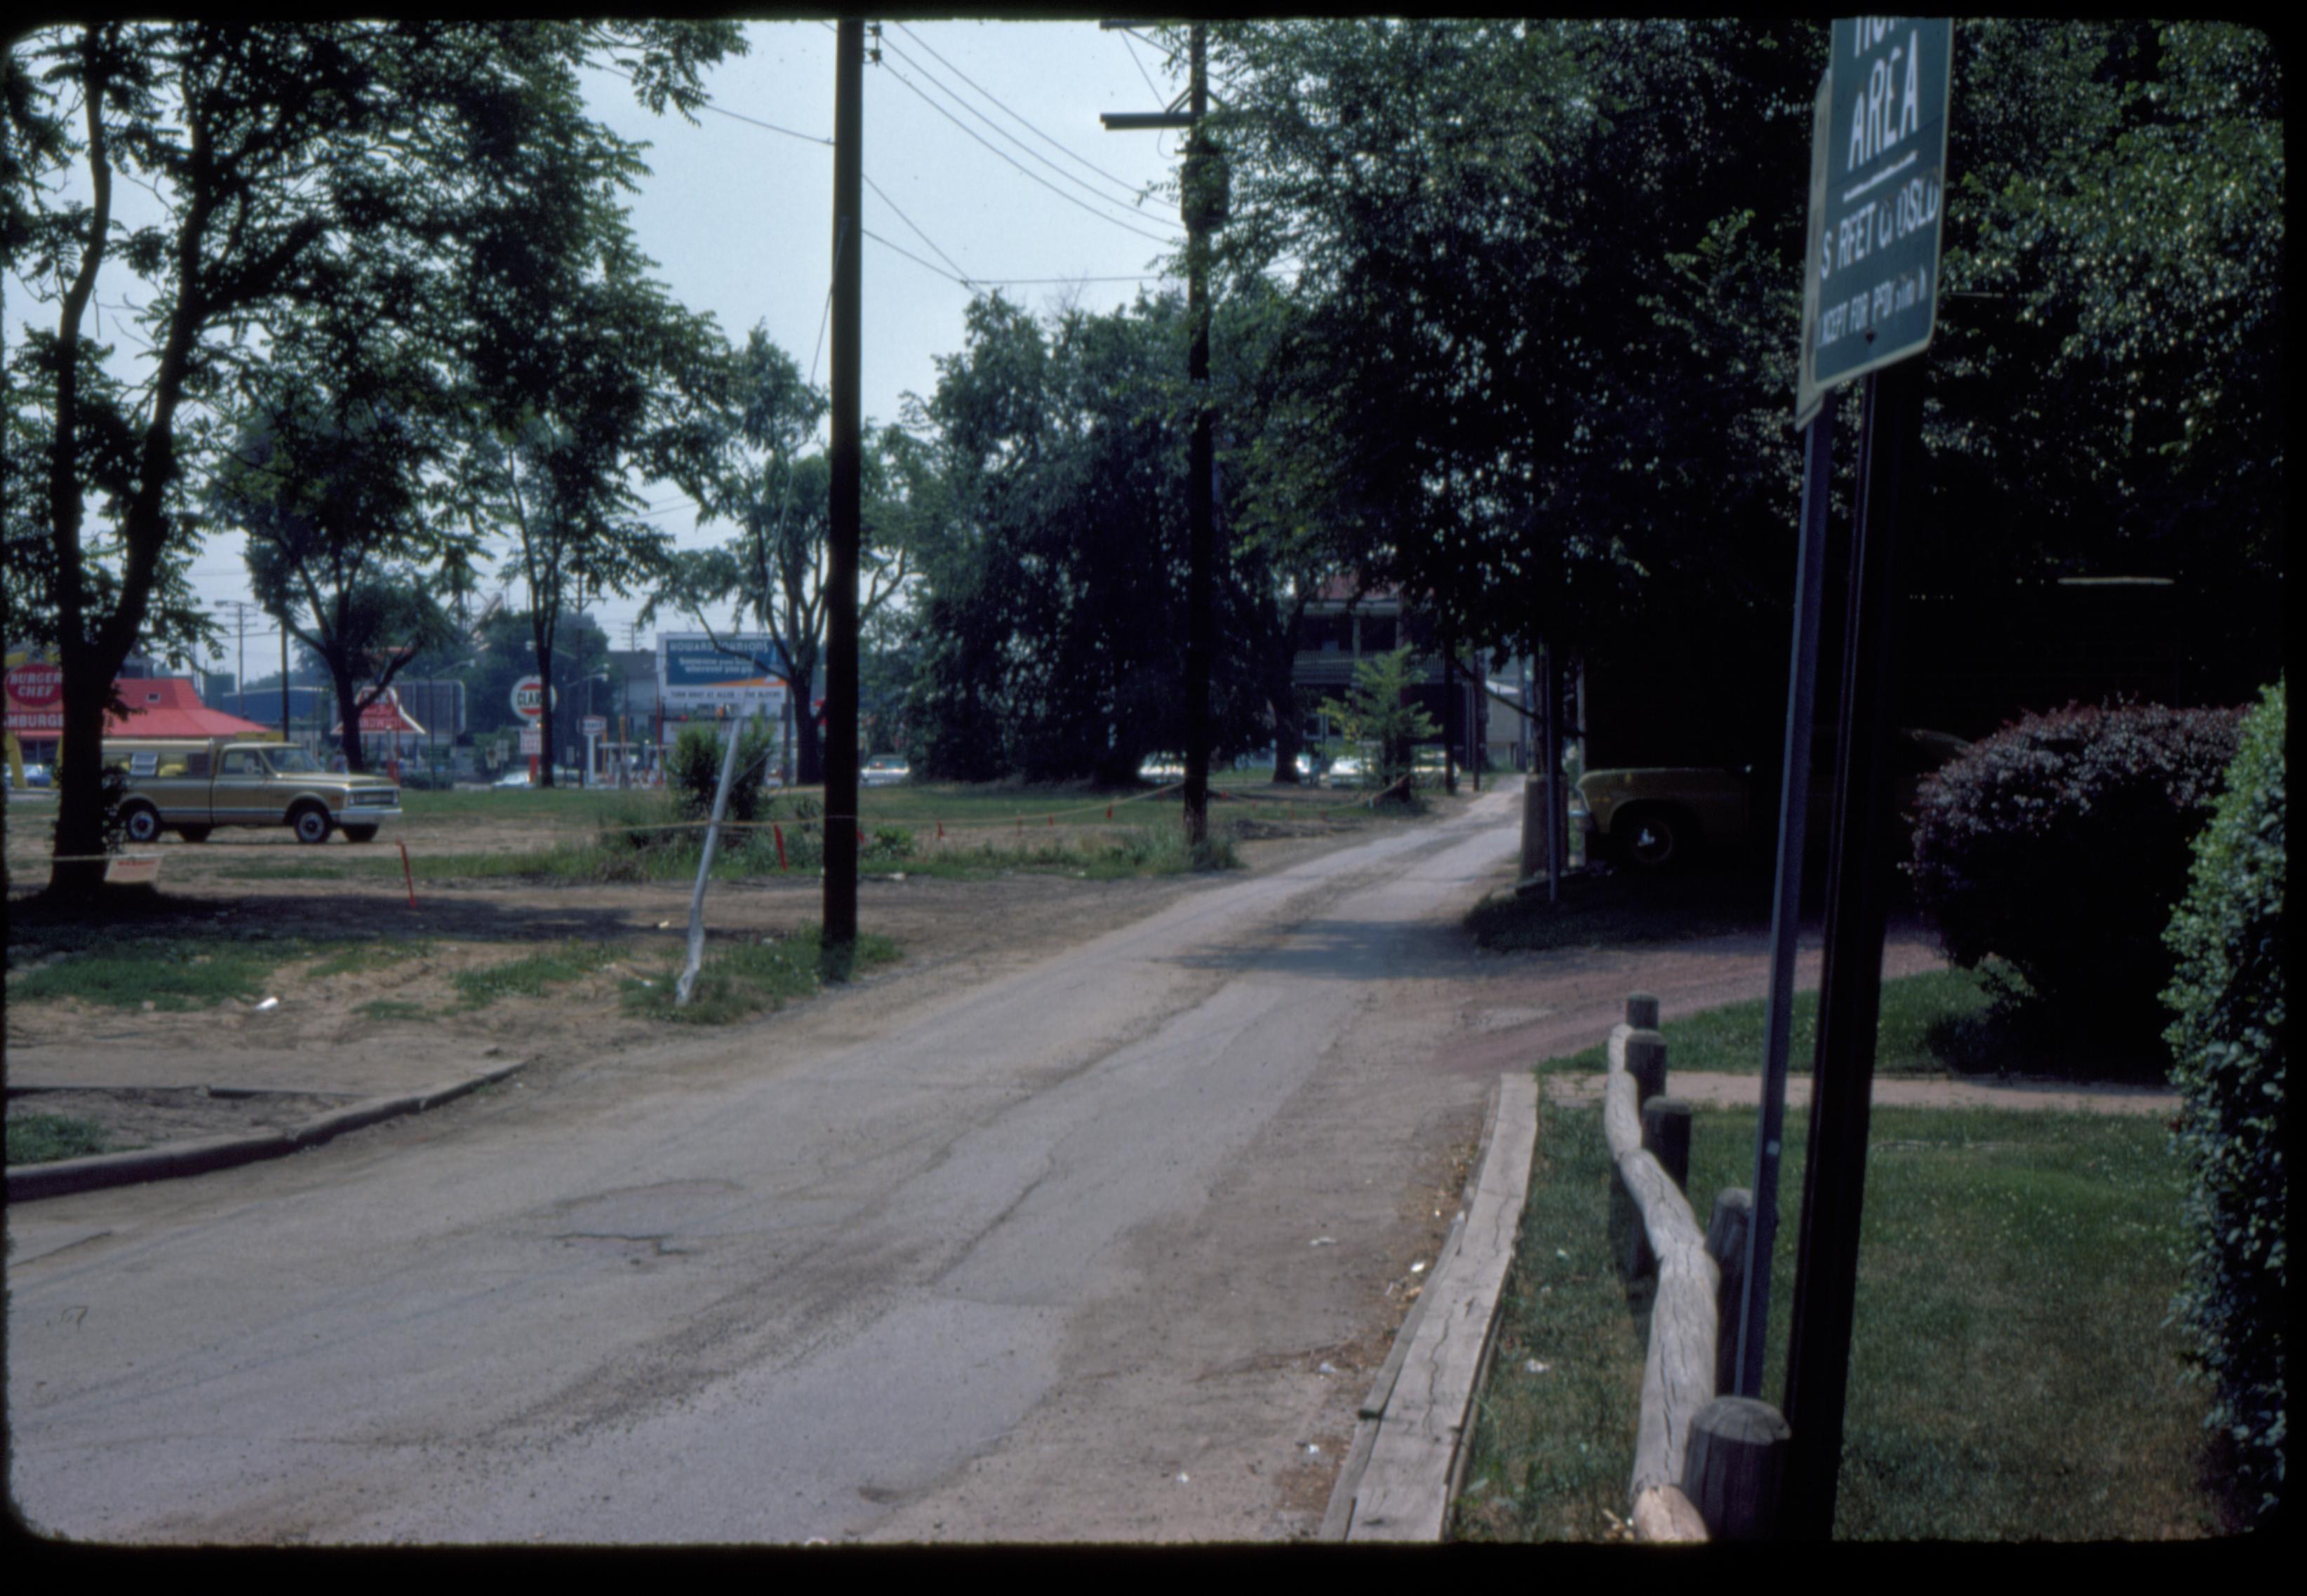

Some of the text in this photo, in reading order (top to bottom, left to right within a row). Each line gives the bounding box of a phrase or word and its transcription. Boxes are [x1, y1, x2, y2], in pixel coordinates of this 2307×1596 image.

[1847, 29, 1918, 170] AREA
[11, 673, 62, 685] BURGER
[18, 685, 53, 697] CHEF
[517, 690, 542, 706] CLAR
